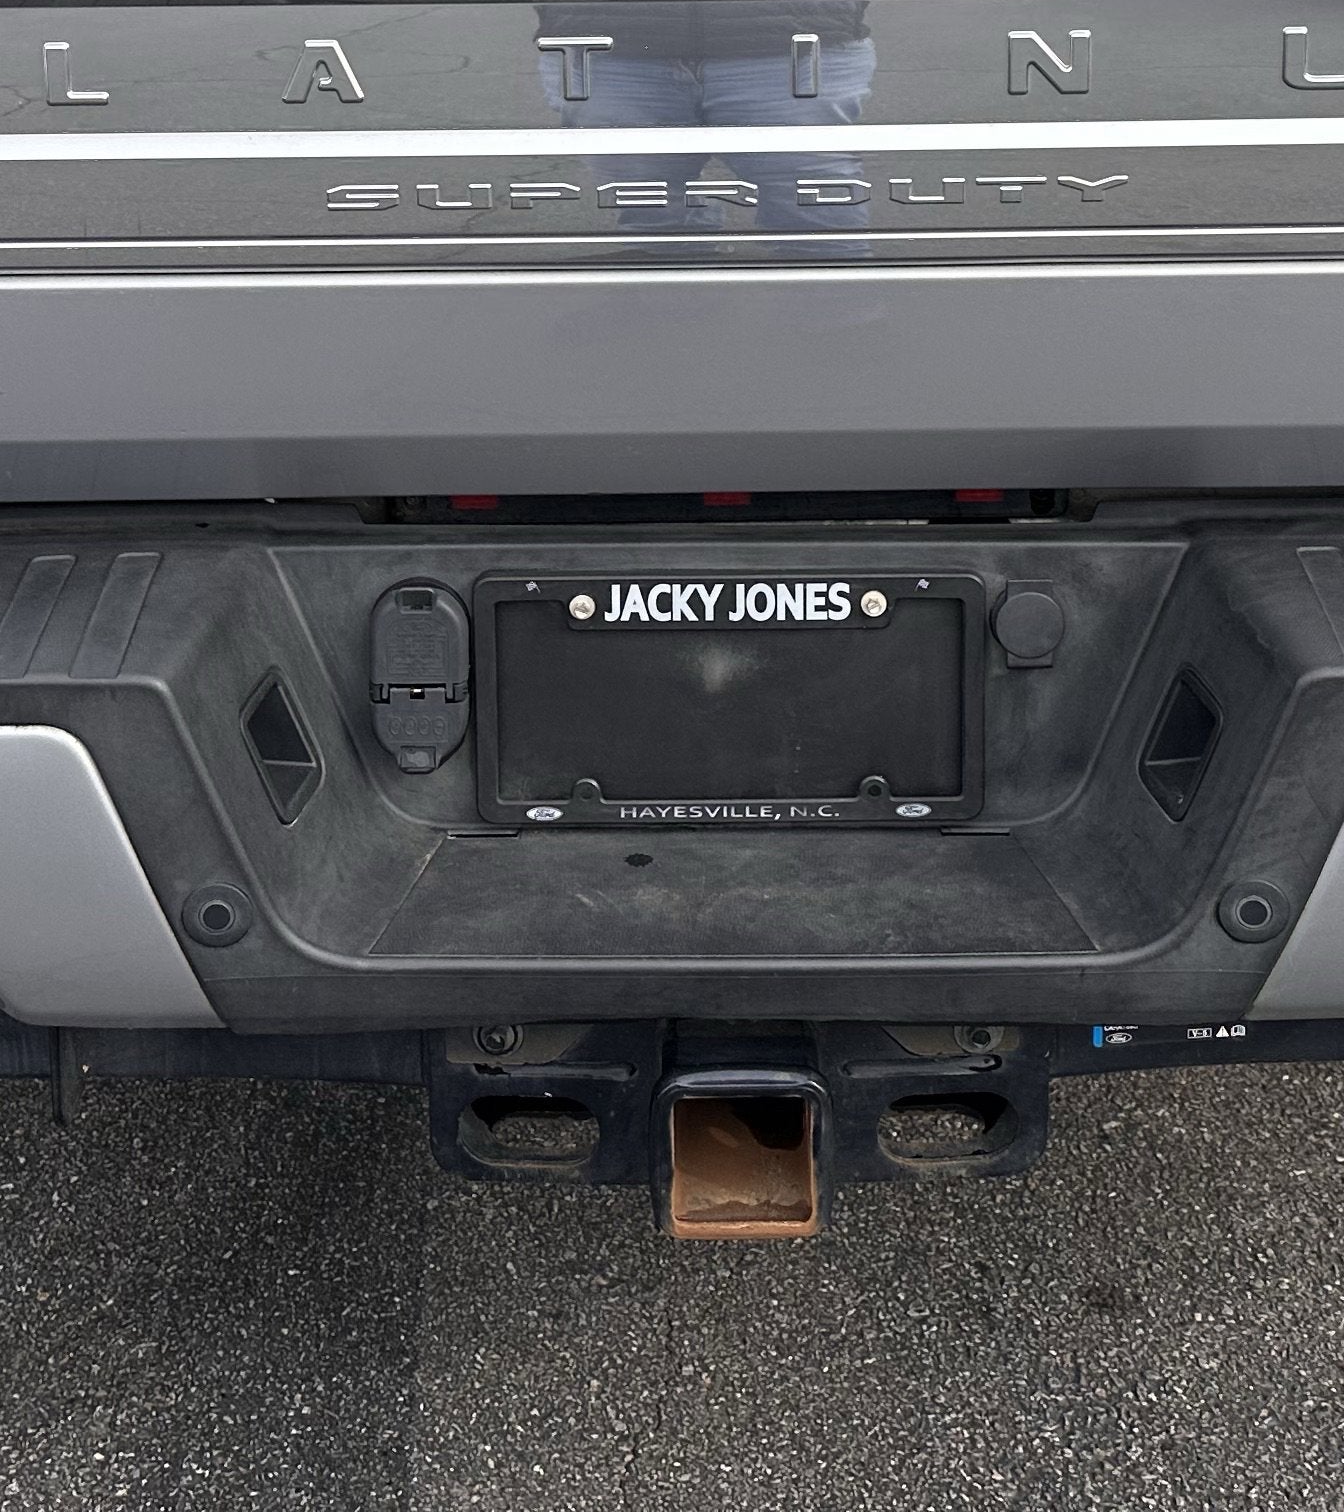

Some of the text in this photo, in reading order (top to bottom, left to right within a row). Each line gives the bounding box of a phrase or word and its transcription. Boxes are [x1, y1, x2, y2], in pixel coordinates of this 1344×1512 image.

[327, 174, 1129, 210] SUPER DUTY
[604, 582, 851, 622] JACKY JONES
[620, 805, 840, 820] HAYESVILLE, N.C.
